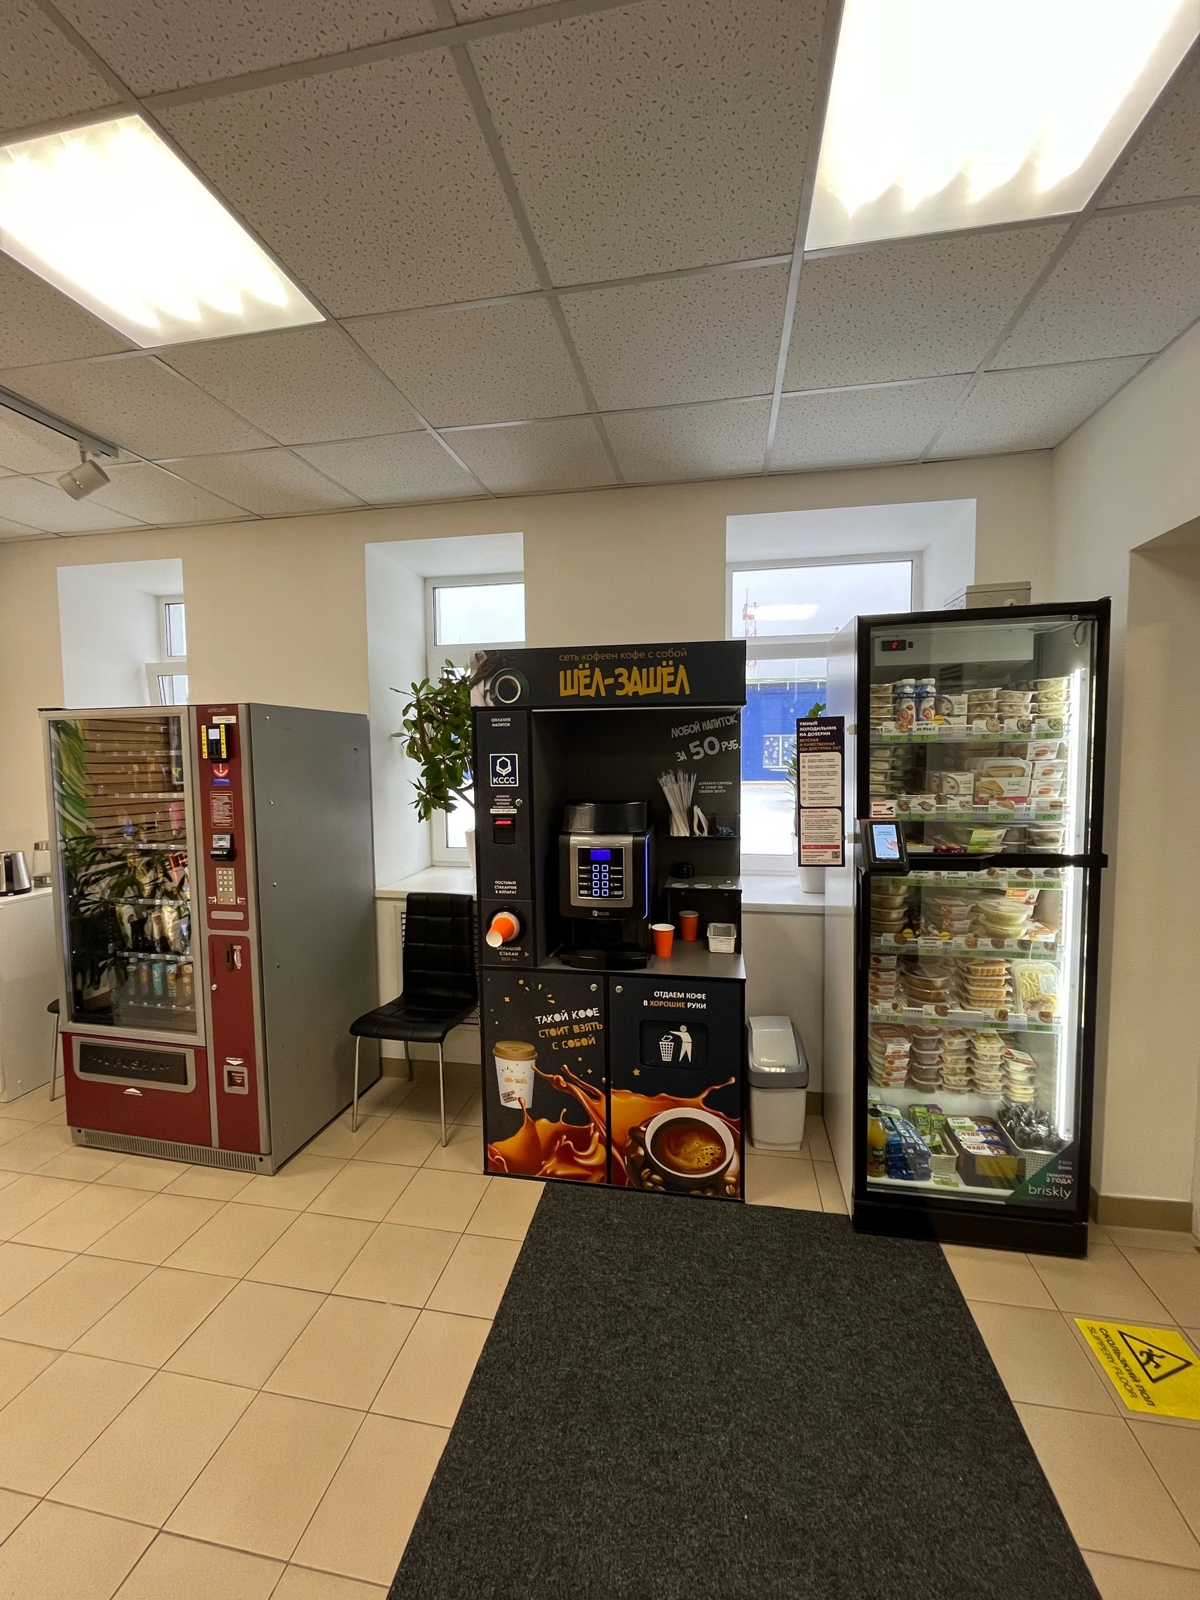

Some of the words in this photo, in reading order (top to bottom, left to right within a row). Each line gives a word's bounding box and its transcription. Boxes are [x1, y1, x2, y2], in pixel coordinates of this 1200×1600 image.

[559, 653, 580, 662] сеть
[582, 651, 618, 662] кофеен
[621, 650, 645, 660] кофе
[656, 648, 687, 658] собой
[559, 660, 690, 697] ШЁЛ-ЗАШЁЛ
[671, 721, 701, 738] ЛЮБОЙ
[702, 714, 738, 731] НАПИТОК
[675, 750, 687, 761] ЗА
[688, 736, 720, 760] 50
[721, 739, 741, 751] РУБ.
[653, 990, 685, 999] ОТДАЕМ
[686, 992, 707, 1000] КОФЕ
[649, 1000, 686, 1008] ХОРОШИЕ
[535, 1009, 569, 1025] ТАКОЙ
[571, 1007, 600, 1020] КОФЕ
[538, 1025, 569, 1038] СТОИТ
[573, 1021, 604, 1034] ВЗЯТЬ
[551, 1042, 559, 1050] С
[561, 1034, 596, 1049] СОБОЙ
[1028, 1184, 1072, 1200] briskly
[1087, 1325, 1117, 1366] SLIPPERY
[1112, 1366, 1138, 1399] FLOOR
[1099, 1327, 1141, 1383] СКОЛЬЗКИЙ
[1136, 1384, 1157, 1407] ПОЛ
